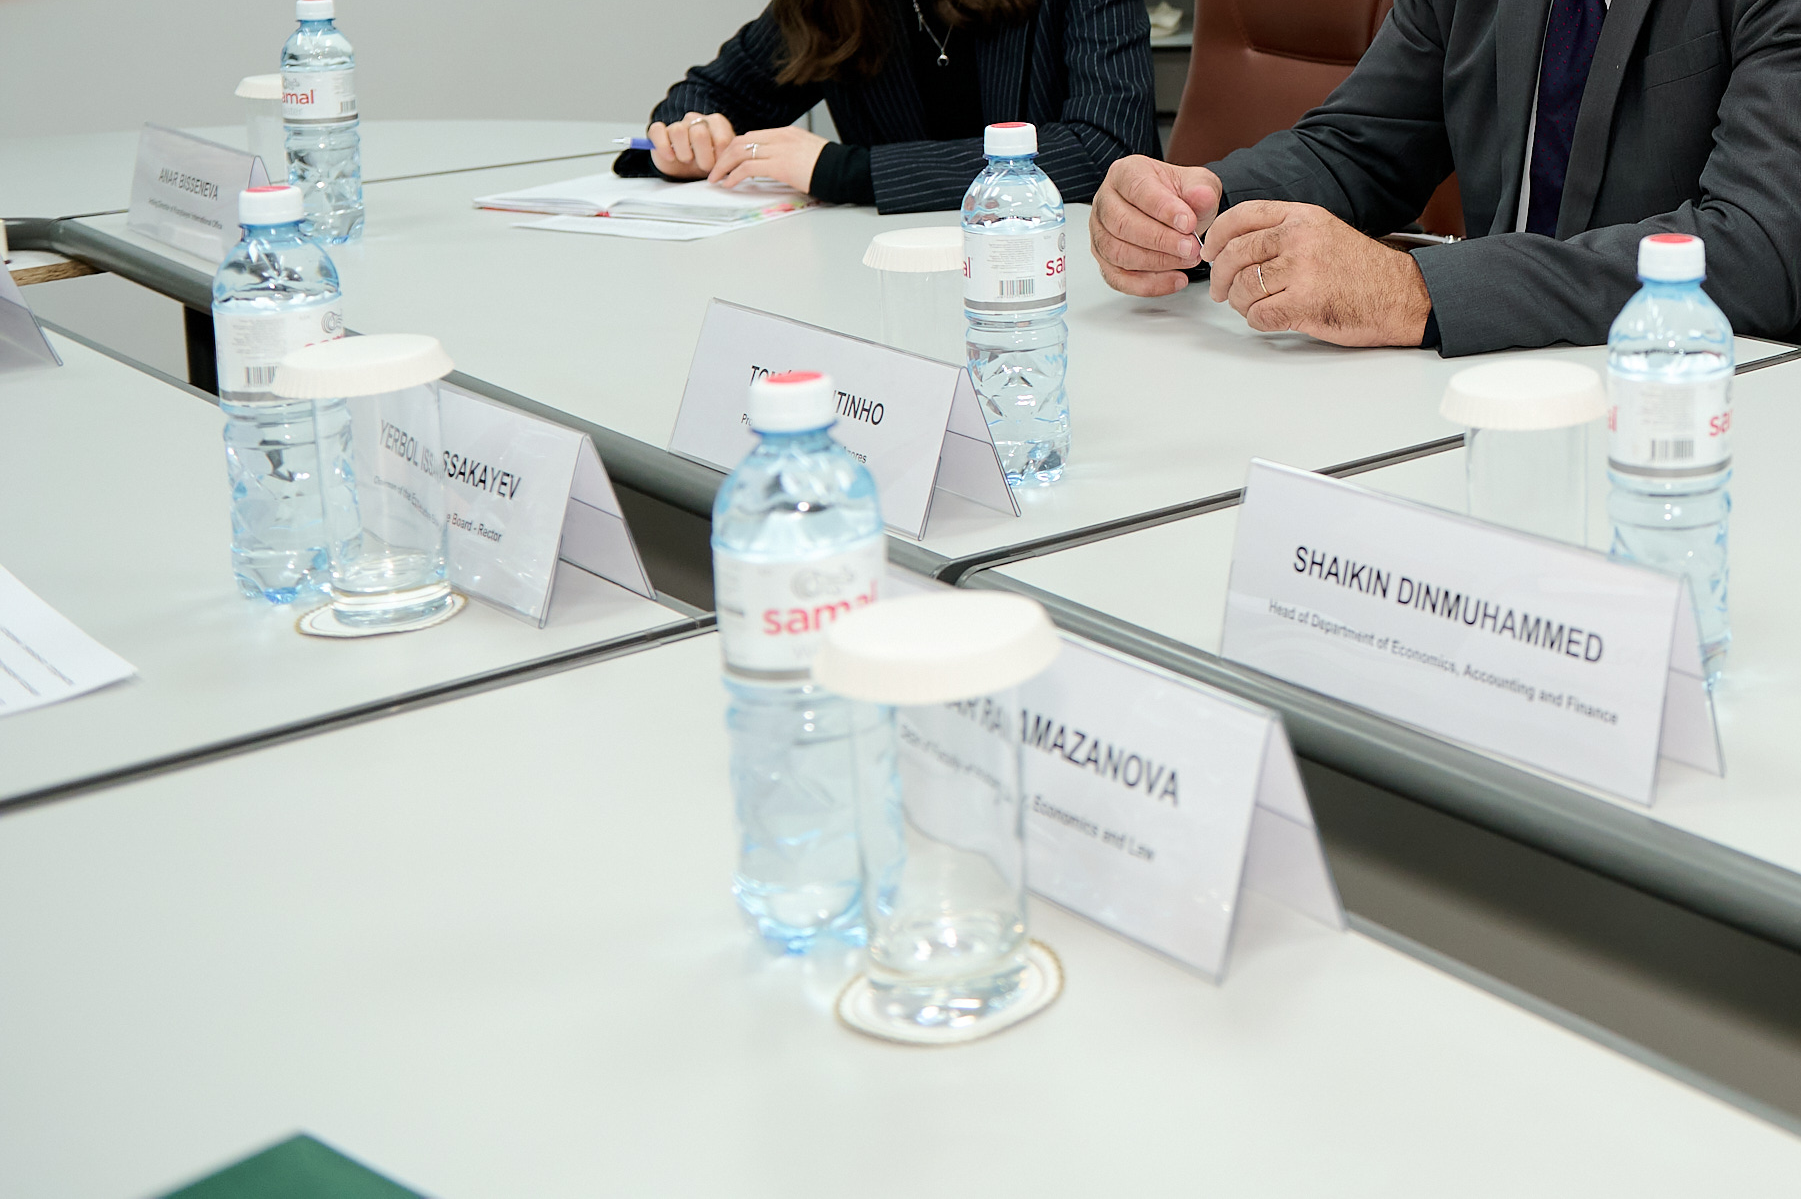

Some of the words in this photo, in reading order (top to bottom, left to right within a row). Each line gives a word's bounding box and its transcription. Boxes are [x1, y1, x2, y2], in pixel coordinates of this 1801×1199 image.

[158, 168, 178, 188] ANAR
[178, 174, 219, 202] BISSENEVA
[451, 512, 473, 532] Board
[477, 523, 503, 543] Rector
[1293, 546, 1390, 599] SHAIKIN
[1397, 576, 1603, 663] DINMUHAMMED
[1268, 599, 1295, 621] Head
[1297, 610, 1310, 624] of
[1310, 613, 1375, 648] Department
[1376, 636, 1390, 651] of
[1390, 639, 1461, 677] Economics,
[1463, 663, 1535, 702] Accounting
[1538, 688, 1563, 707] and
[1565, 694, 1618, 724] Finance
[1032, 795, 1099, 838] Economics
[1101, 825, 1126, 850] and
[1127, 837, 1155, 862] Law
